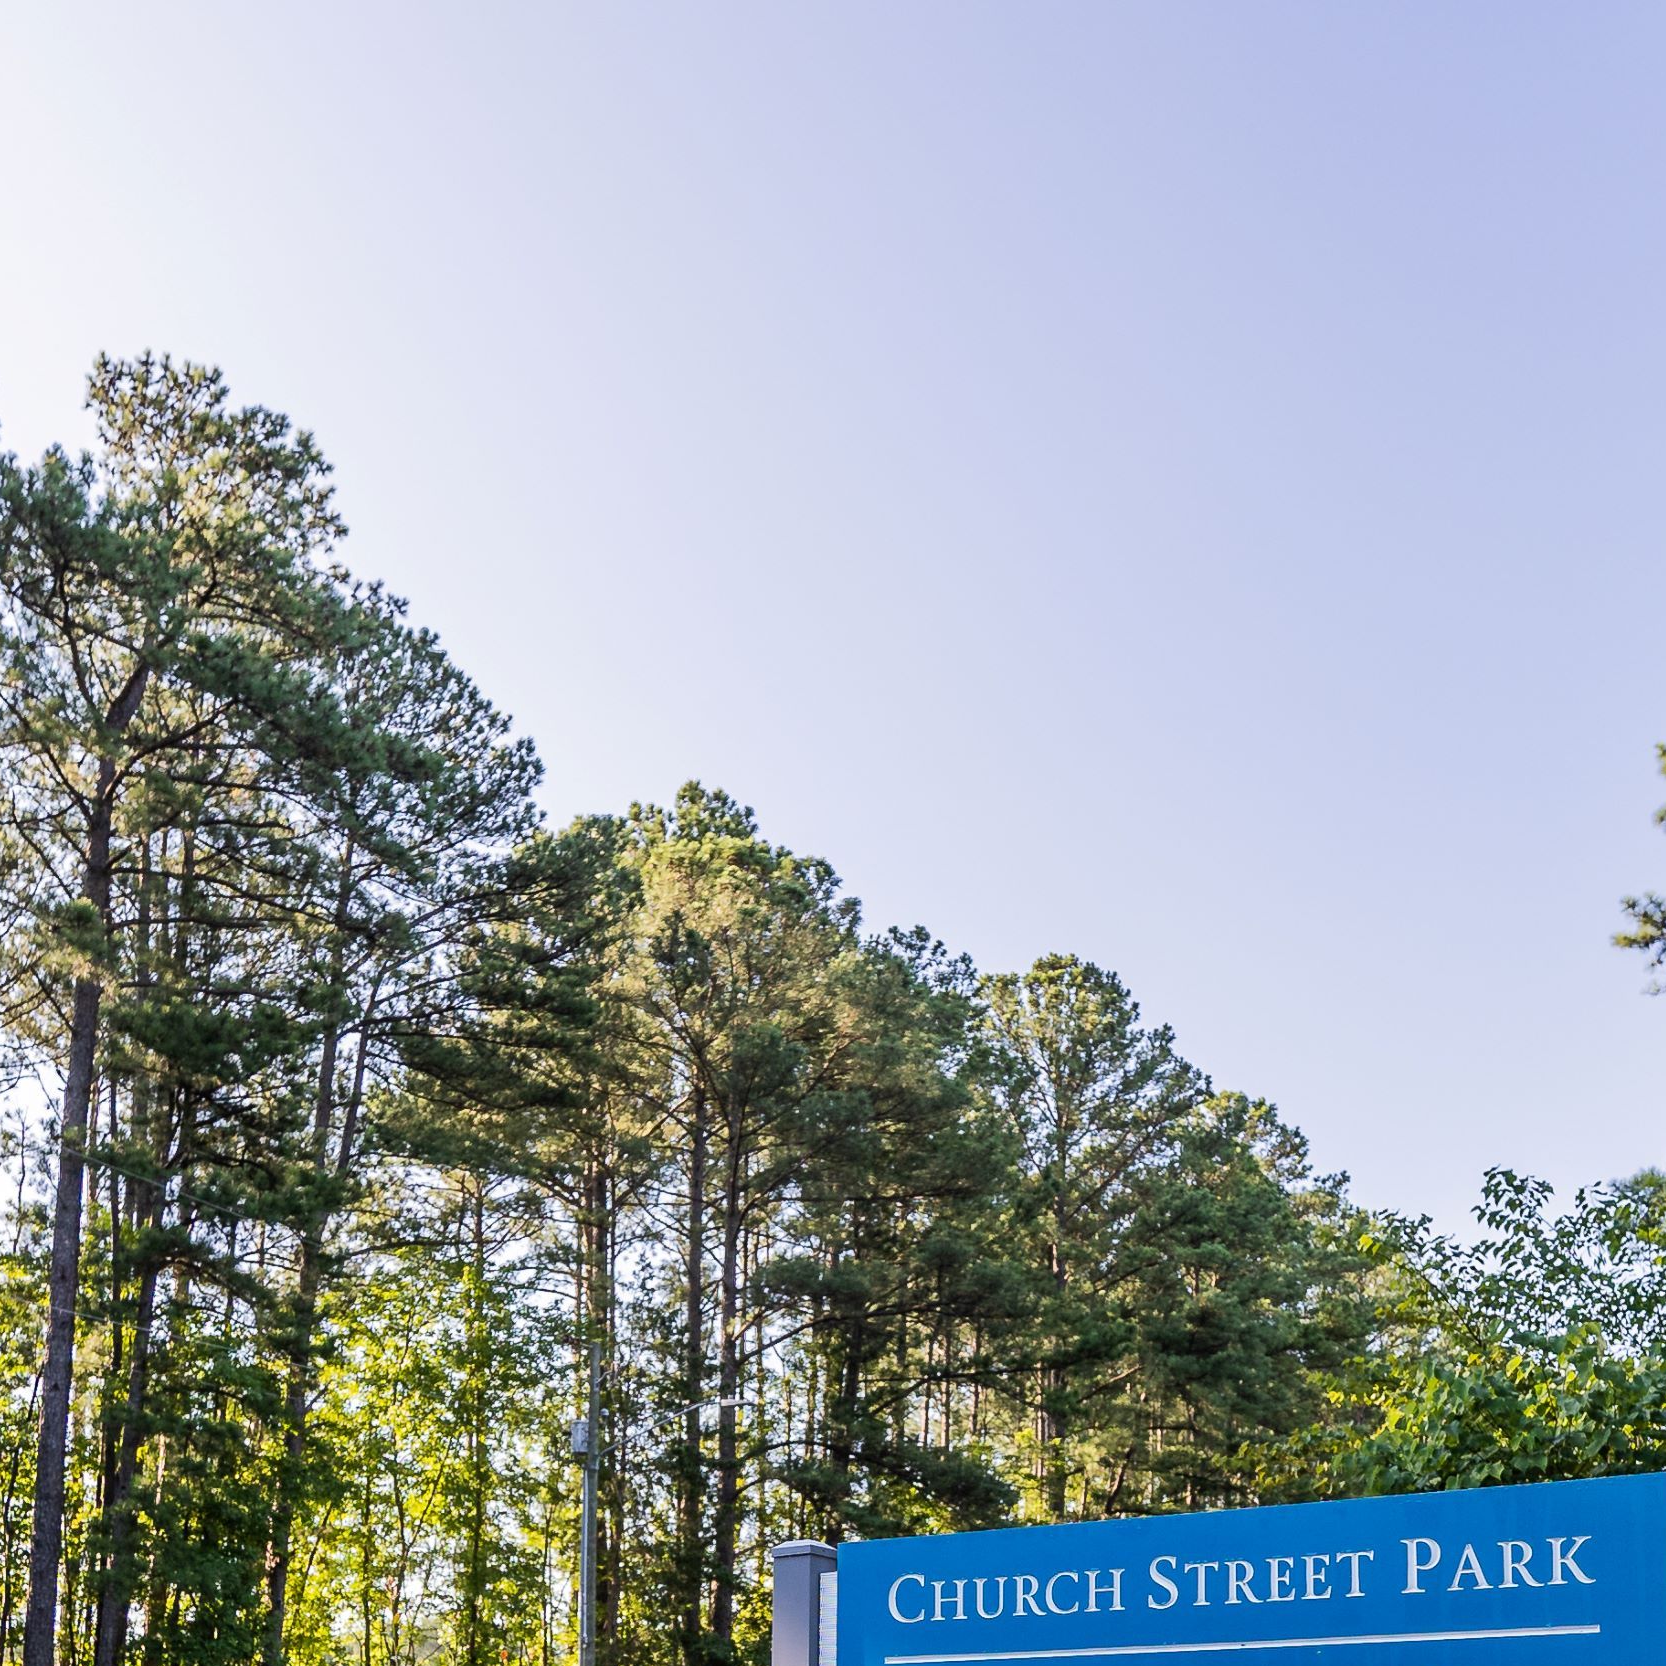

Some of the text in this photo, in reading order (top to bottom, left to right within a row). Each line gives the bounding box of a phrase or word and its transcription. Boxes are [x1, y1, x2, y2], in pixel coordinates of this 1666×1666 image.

[887, 1535, 1597, 1624] CHURCH STREET PARK
